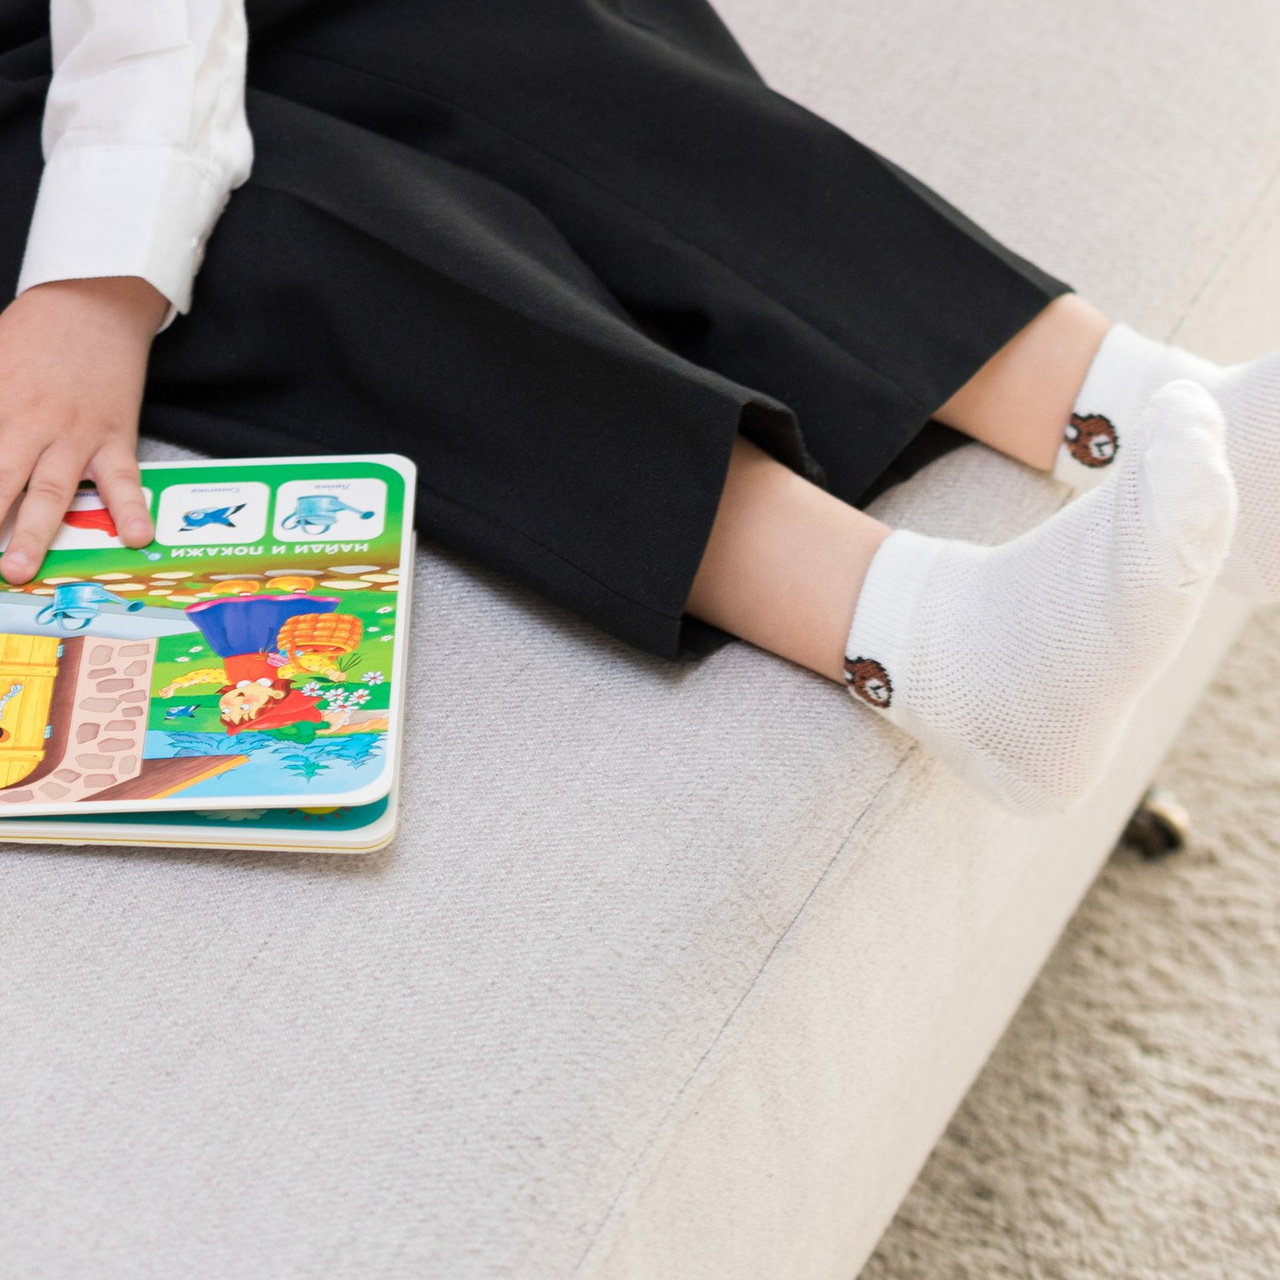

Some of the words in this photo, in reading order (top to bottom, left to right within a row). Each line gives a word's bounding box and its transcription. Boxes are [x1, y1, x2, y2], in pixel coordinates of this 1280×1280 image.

[170, 545, 264, 559] ПОКАЖИ
[272, 545, 286, 555] И
[295, 542, 369, 555] НАЙДИ
